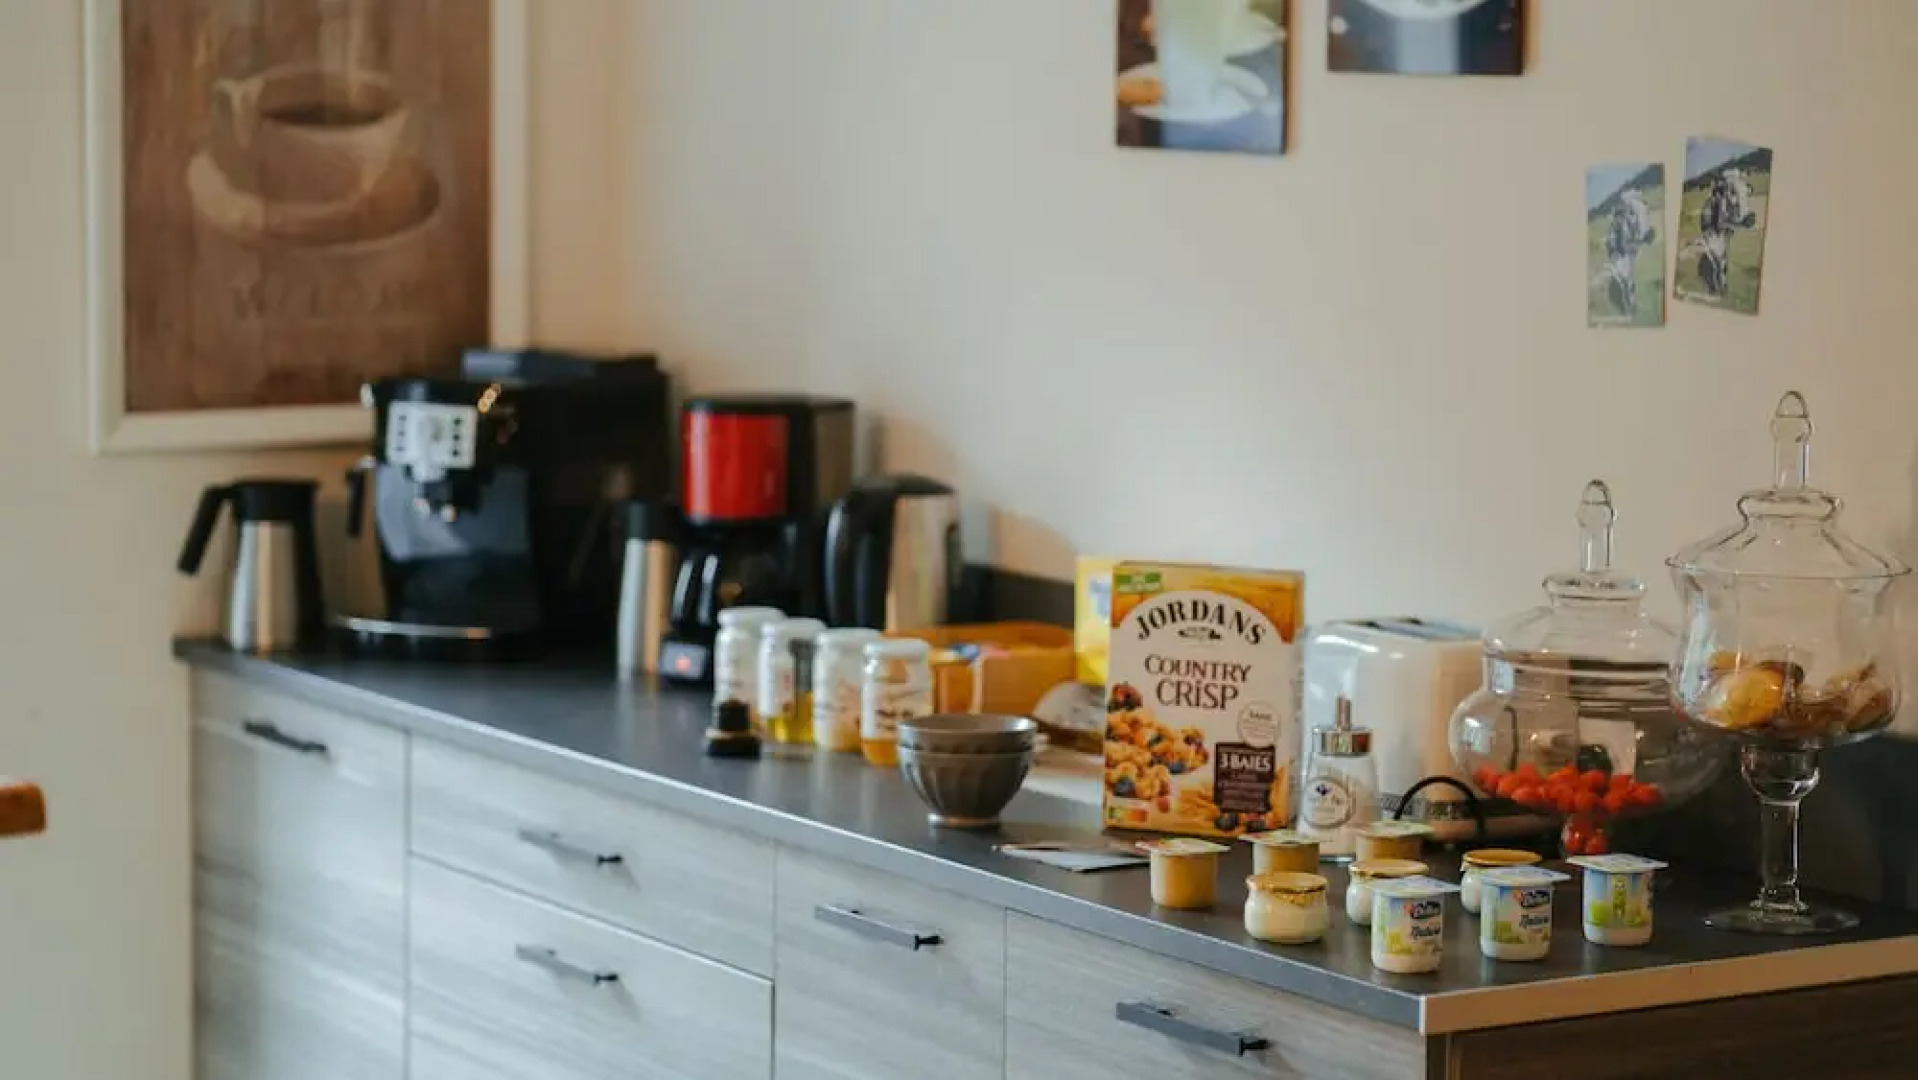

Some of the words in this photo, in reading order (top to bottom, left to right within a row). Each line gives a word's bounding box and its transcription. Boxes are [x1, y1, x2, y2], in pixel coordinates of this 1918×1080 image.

[1136, 598, 1266, 645] JORDANS
[1144, 653, 1252, 683] COUNTRY
[1219, 752, 1228, 768] 3
[1230, 753, 1271, 772] BAIES
